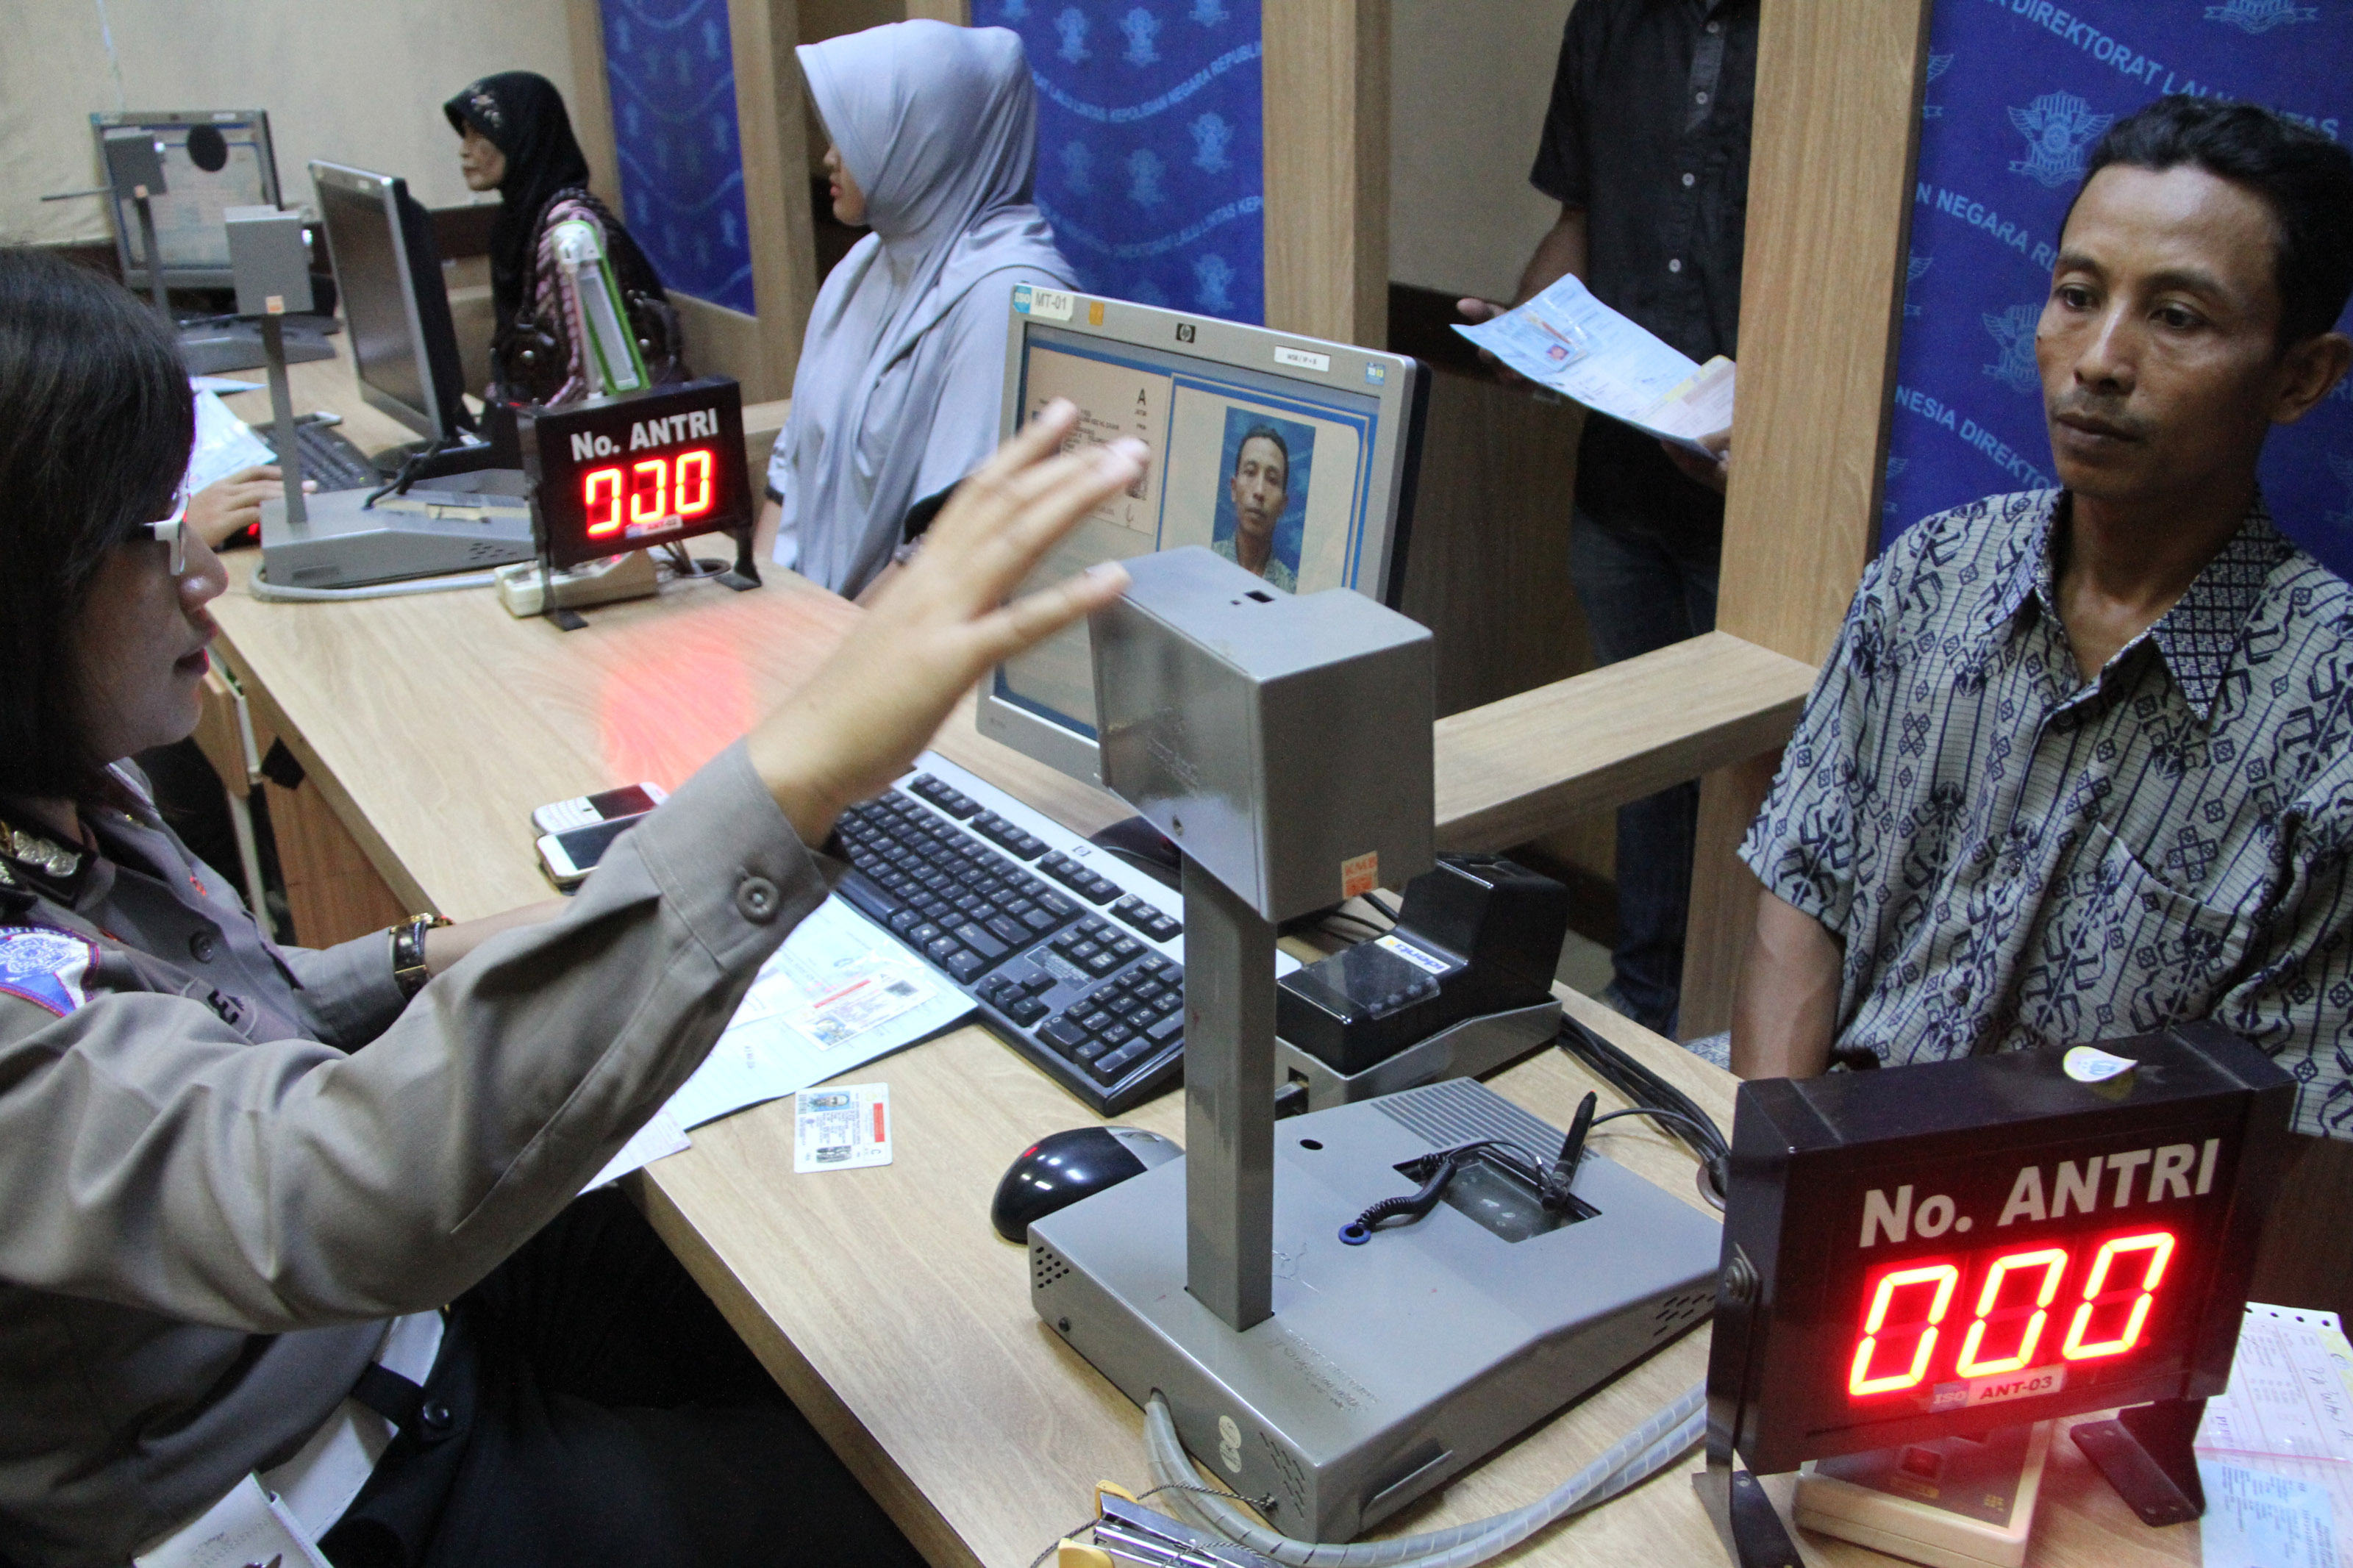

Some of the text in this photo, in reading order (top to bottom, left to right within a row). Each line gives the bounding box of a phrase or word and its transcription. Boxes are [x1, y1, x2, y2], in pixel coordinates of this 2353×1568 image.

[2011, 0, 2164, 85] DIREKTORAT
[1936, 188, 2029, 254] NEGARA
[1035, 292, 1067, 310] MT-01
[1137, 387, 1147, 407] A
[1894, 384, 1956, 432] NESIA
[570, 407, 719, 462] No. ANTRI
[1859, 1138, 2221, 1248] No. ANTRI
[1849, 1231, 2176, 1397] 000
[1932, 1375, 2053, 1405] ISO ANT-03
